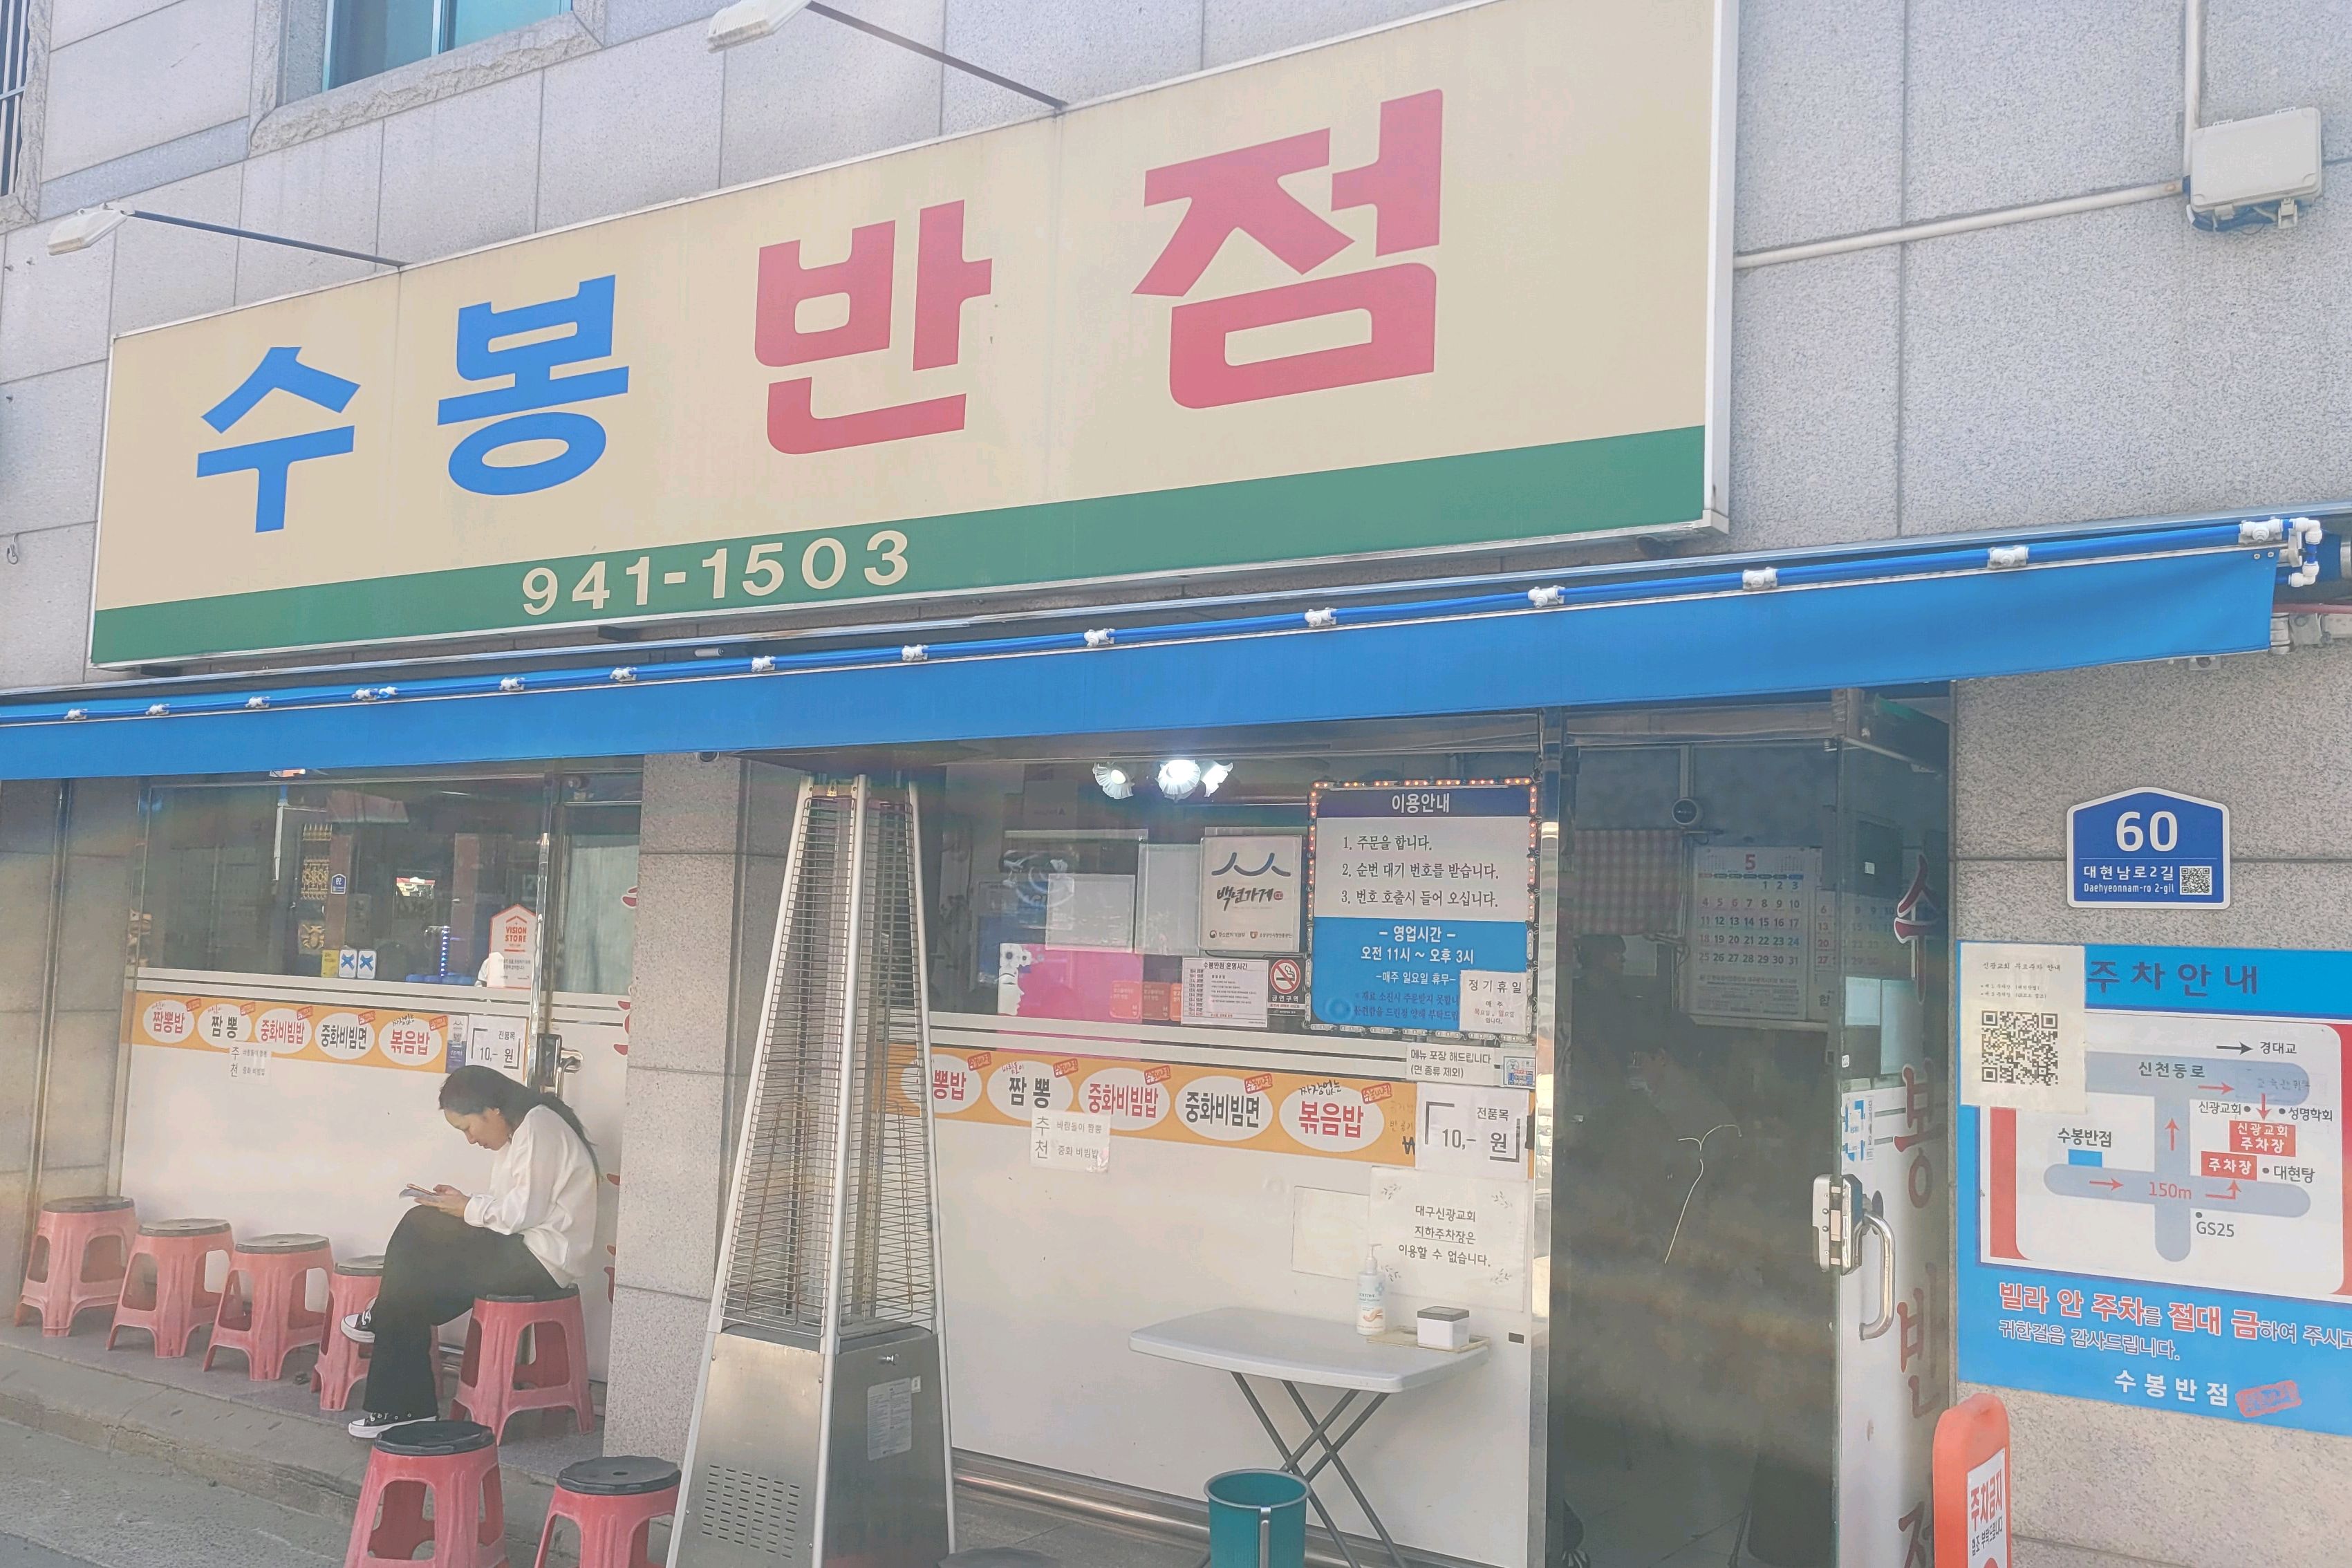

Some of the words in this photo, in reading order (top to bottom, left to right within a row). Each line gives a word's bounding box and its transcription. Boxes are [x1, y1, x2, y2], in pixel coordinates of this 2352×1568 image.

[522, 530, 910, 615] 941-1503
[1392, 792, 1450, 813] 이용안내
[2116, 811, 2178, 852] 60
[1343, 837, 1352, 850] 1.
[1357, 835, 1391, 850] 주문을
[1395, 835, 1432, 851] 합니다.
[1342, 864, 1352, 877] 2.
[1356, 862, 1379, 877] 순번
[1383, 863, 1405, 878] 대기
[1410, 863, 1444, 879] 번호를
[1448, 864, 1499, 879] 받습니다.
[1744, 854, 1756, 870] 5
[2084, 865, 2174, 881] 대현남로2길
[1216, 886, 1274, 911] 백년가게
[1341, 890, 1351, 904] 3.
[1356, 889, 1378, 904] 번호
[1383, 890, 1415, 906] 호출시
[1419, 890, 1443, 906] 들어
[1447, 891, 1498, 908] 오십니다.
[2084, 884, 2152, 894] Daehyeonnam-ro
[2154, 884, 2174, 895] 2-gil
[1393, 926, 1441, 943] 영업시간
[1361, 946, 1382, 960] 오전
[1387, 949, 1410, 962] 11시
[1429, 949, 1452, 963] 오후
[1456, 949, 1474, 964] 3시
[1403, 972, 1428, 985] 일요일
[1468, 979, 1522, 993] 정기휴일
[2087, 961, 2257, 998] 주차안내
[153, 1011, 185, 1034] 짬뽕밥
[212, 1016, 238, 1039] 짬뽕
[261, 1020, 305, 1045] 중화비빔밥
[321, 1024, 367, 1050] 중화비빔면
[498, 1031, 515, 1041] 전품목
[390, 1029, 430, 1056] 볶음밥
[2259, 1041, 2297, 1055] 경대교
[505, 1048, 513, 1063] 원
[1410, 1049, 1427, 1060] 메뉴
[1429, 1051, 1446, 1061] 포장
[1449, 1052, 1491, 1064] 해드립니다
[1410, 1064, 1422, 1075] (면
[1425, 1066, 1441, 1076] 종류
[1443, 1067, 1464, 1078] 제외)
[2138, 1061, 2205, 1079] 신천동로
[933, 1070, 967, 1101] 뽕밥
[1008, 1076, 1051, 1109] 짬뽕
[1088, 1083, 1158, 1118] 중화비빔밥
[1185, 1091, 1260, 1128] 중화비빔면
[2199, 1101, 2241, 1115] 신광교회
[1298, 1100, 1364, 1139] 볶음밥
[1476, 1107, 1509, 1121] 전품목
[2288, 1107, 2333, 1121] 성명학회
[2057, 1128, 2112, 1148] 수봉반점
[2237, 1122, 2288, 1137] 신광교회
[1490, 1132, 1507, 1153] 원
[2240, 1137, 2284, 1154] 주차장
[1058, 1145, 1072, 1156] 중화
[1076, 1147, 1098, 1159] 비빔밥
[2208, 1158, 2252, 1175] 주차장
[2273, 1166, 2315, 1184] 대현탕
[2149, 1182, 2192, 1200] 150m
[1415, 1205, 1476, 1222] 대구신광교회
[1415, 1226, 1476, 1244] 지하주차장은
[2196, 1221, 2234, 1238] GS25
[1399, 1244, 1427, 1260] 이용할
[1432, 1249, 1442, 1260] 수
[1448, 1250, 1491, 1267] 없습니다.
[1999, 1282, 2048, 1314] 빌라
[2057, 1289, 2084, 1317] 안
[2091, 1294, 2162, 1327] 주차를
[2168, 1302, 2221, 1336] 절대
[2231, 1309, 2296, 1344] 금하여
[1999, 1319, 2066, 1345] 귀한걸음
[2070, 1327, 2180, 1361] 감사드립니다.
[2114, 1369, 2228, 1407] 수봉반점
[1971, 1468, 2002, 1532] 주차금지
